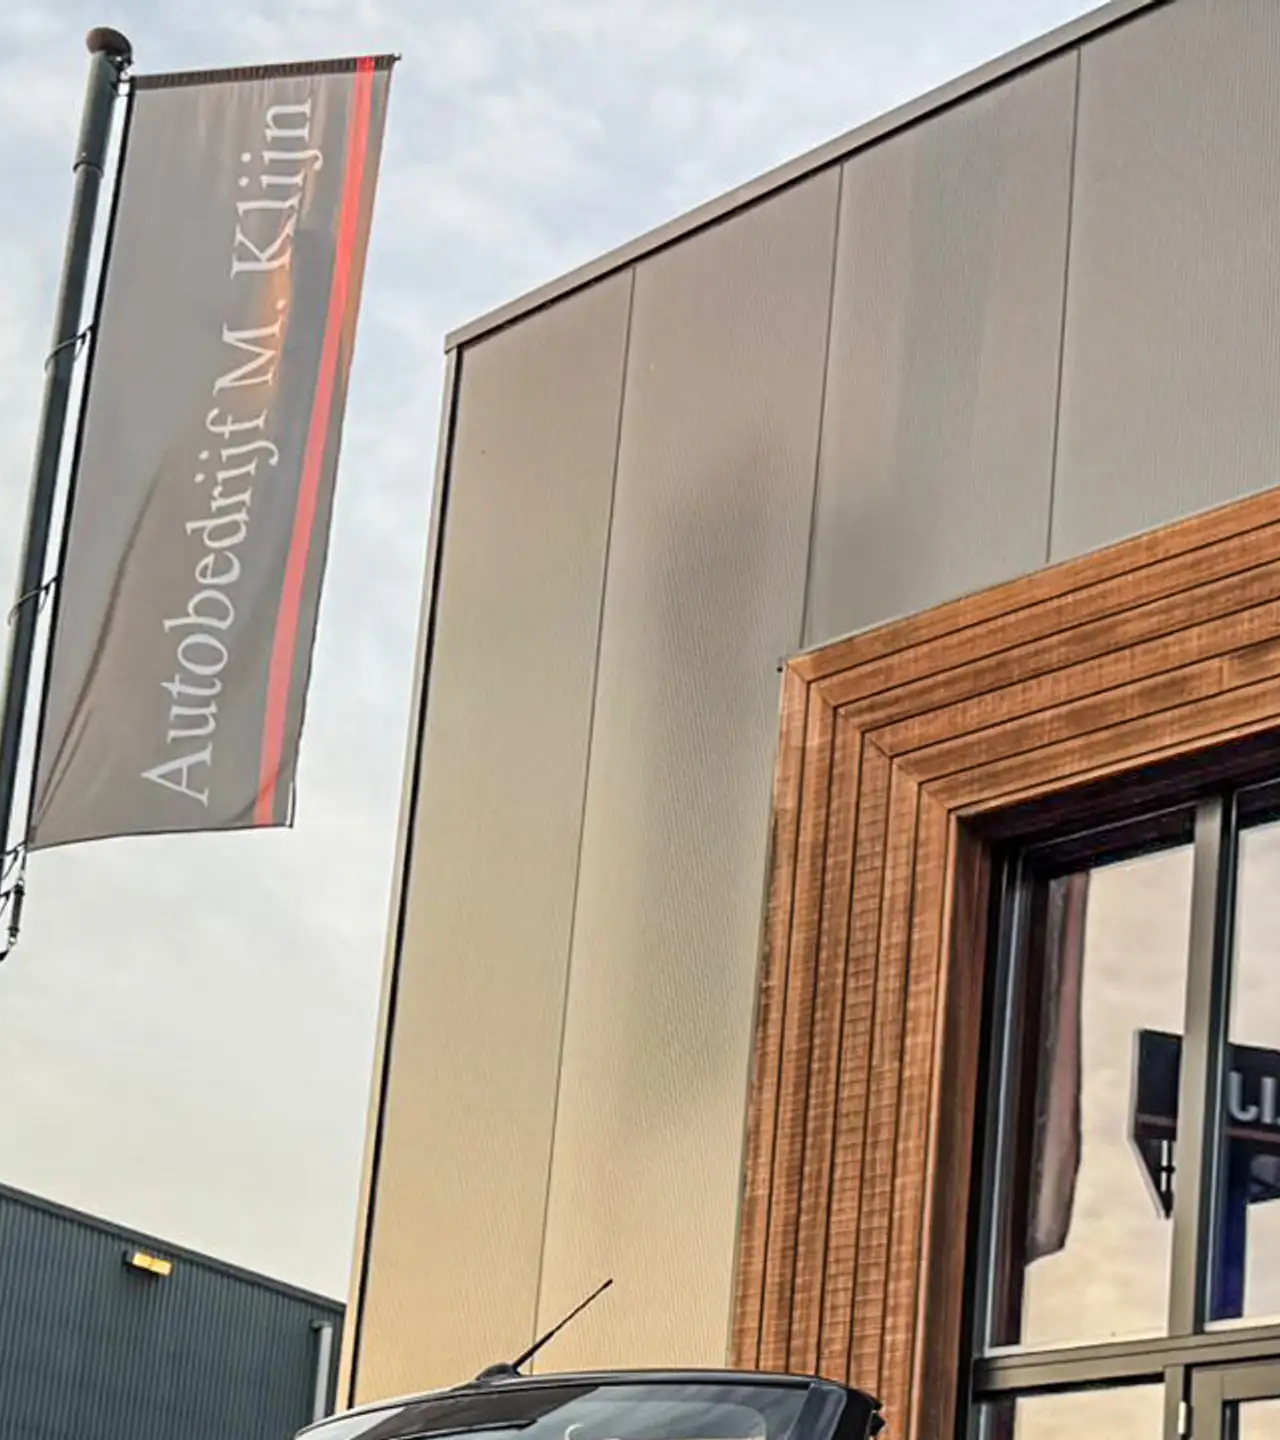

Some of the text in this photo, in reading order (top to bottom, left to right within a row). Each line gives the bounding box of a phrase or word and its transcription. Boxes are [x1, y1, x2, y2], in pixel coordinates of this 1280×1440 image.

[141, 96, 322, 806] Autobedrijf M. Klijn
